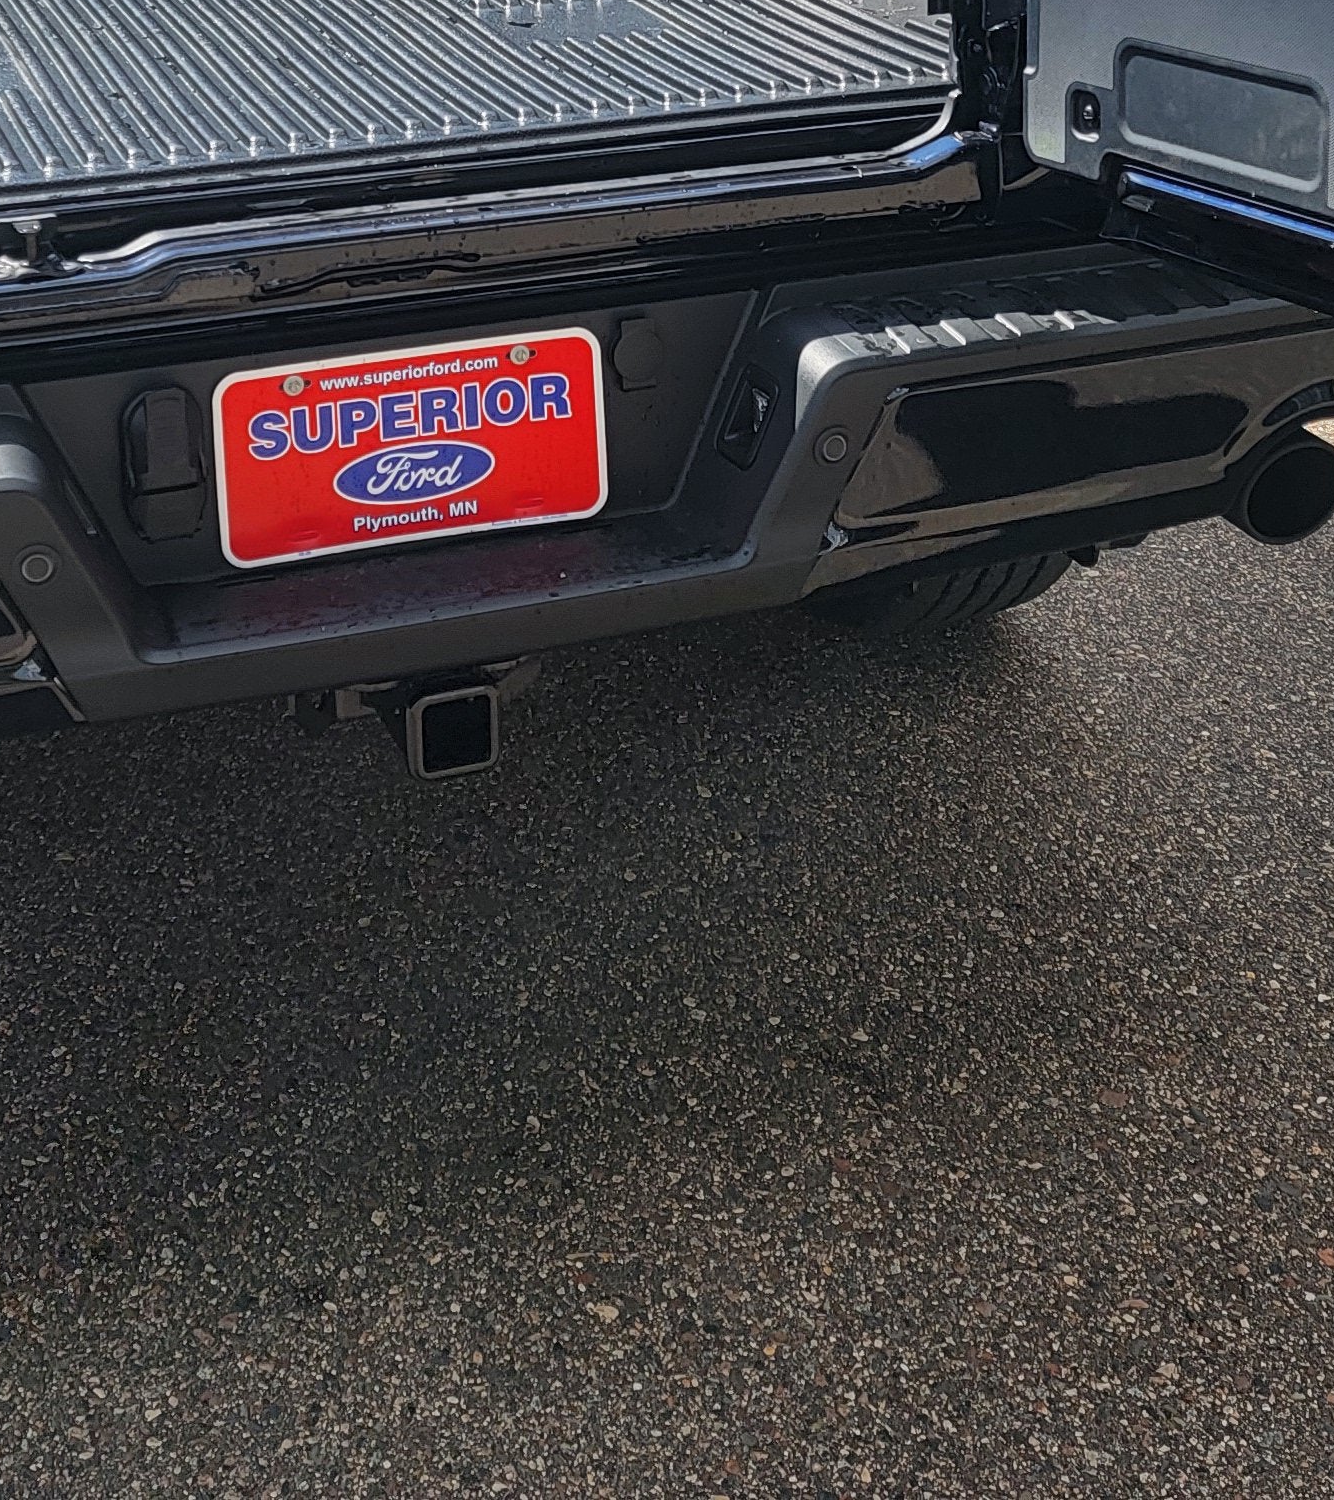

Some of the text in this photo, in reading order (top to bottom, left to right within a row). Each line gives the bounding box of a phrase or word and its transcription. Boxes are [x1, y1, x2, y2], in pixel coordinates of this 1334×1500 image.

[319, 355, 499, 391] www.superiorford.com
[248, 372, 572, 461] SUPERIOR
[367, 449, 463, 496] Ford
[353, 500, 478, 532] Plymouth, MN
